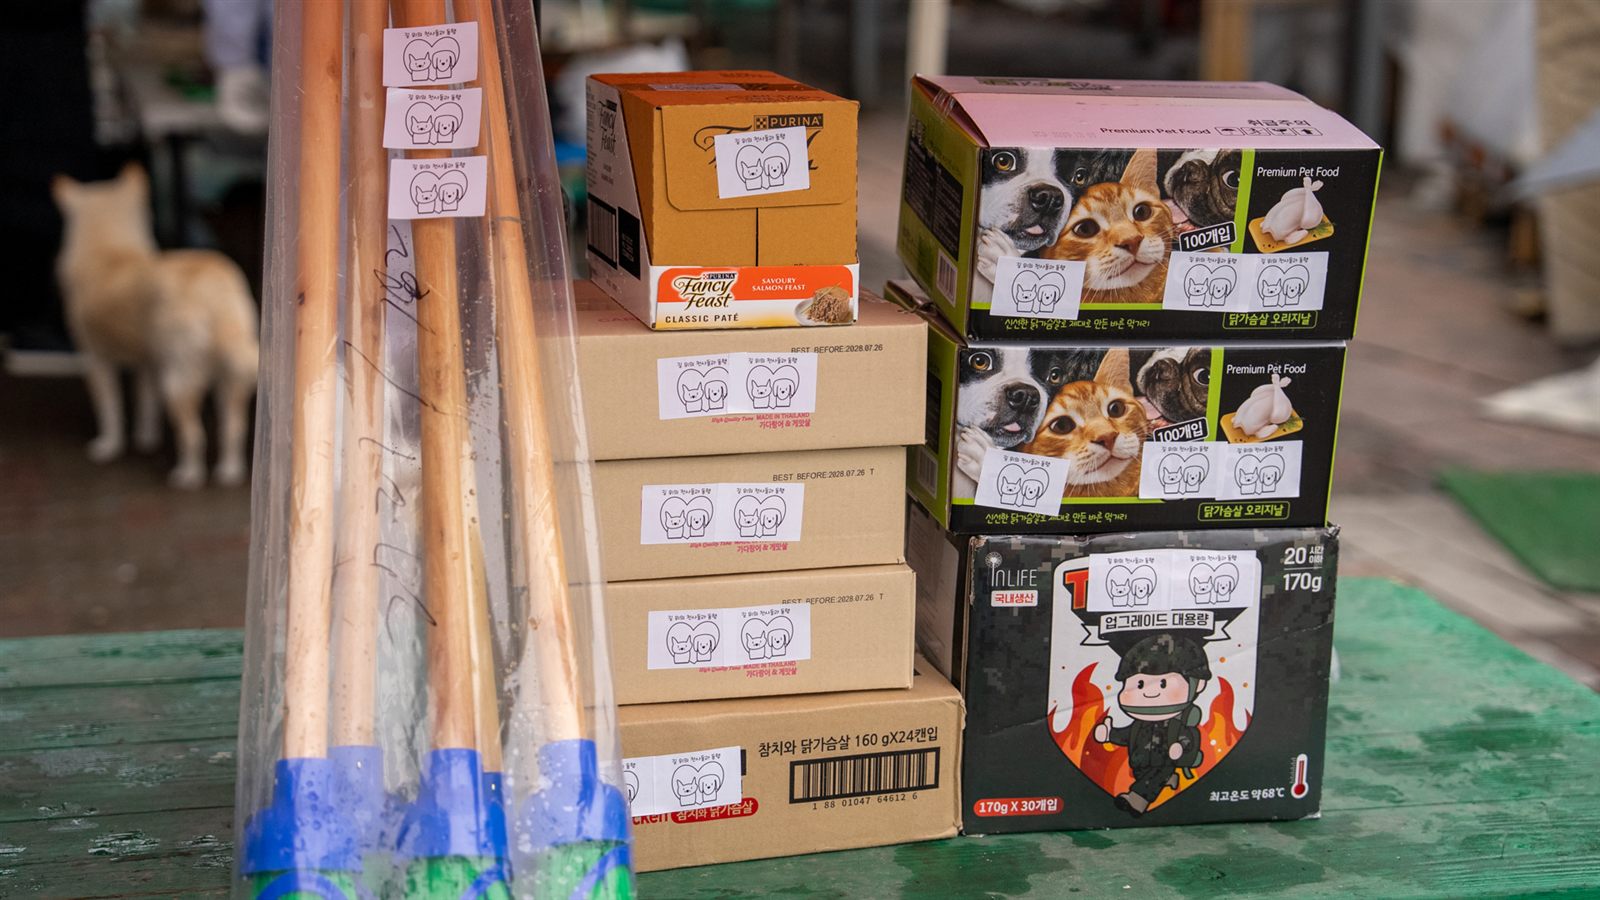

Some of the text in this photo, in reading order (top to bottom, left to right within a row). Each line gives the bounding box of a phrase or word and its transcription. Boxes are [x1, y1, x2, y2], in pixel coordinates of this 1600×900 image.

[771, 117, 820, 127] PURINA
[1248, 119, 1311, 127] 취급주의
[1100, 127, 1157, 135] Premium
[1257, 166, 1339, 177] Premium Pet Food
[1183, 226, 1231, 249] 100개입
[674, 277, 734, 296] Fancy
[683, 292, 731, 311] Feast
[665, 313, 739, 323] CLASSIC PATÉ
[1004, 318, 1029, 329] 신선한
[1030, 318, 1067, 330] 닭가슴살로
[1069, 319, 1092, 328] 제대로
[1094, 319, 1108, 329] 만든
[1110, 319, 1125, 329] 바른
[1229, 312, 1311, 326] 닭가슴살 오리지날
[1226, 364, 1306, 374] Premium Pet Food
[1158, 422, 1203, 442] 100개입
[1204, 504, 1284, 518] 닭가슴살 오리지날
[986, 513, 1009, 524] 신선한
[1011, 513, 1046, 525] 닭가슴살로
[1072, 512, 1086, 523] 만든
[1088, 512, 1103, 523] 바른
[1284, 547, 1306, 565] 20
[1309, 546, 1324, 554] 시간
[1283, 572, 1322, 592] 170g
[994, 593, 1034, 604] 국내생산
[1105, 613, 1209, 629] 업그레이드 대용량
[758, 726, 938, 757] 참치와 닭가슴살 160 gX24캔입
[824, 801, 836, 809] 88
[842, 797, 871, 807] 01047
[878, 794, 906, 803] 64612
[913, 792, 918, 800] 6
[1209, 790, 1249, 802] 최고온도
[979, 798, 1058, 814] 170g X 30개입
